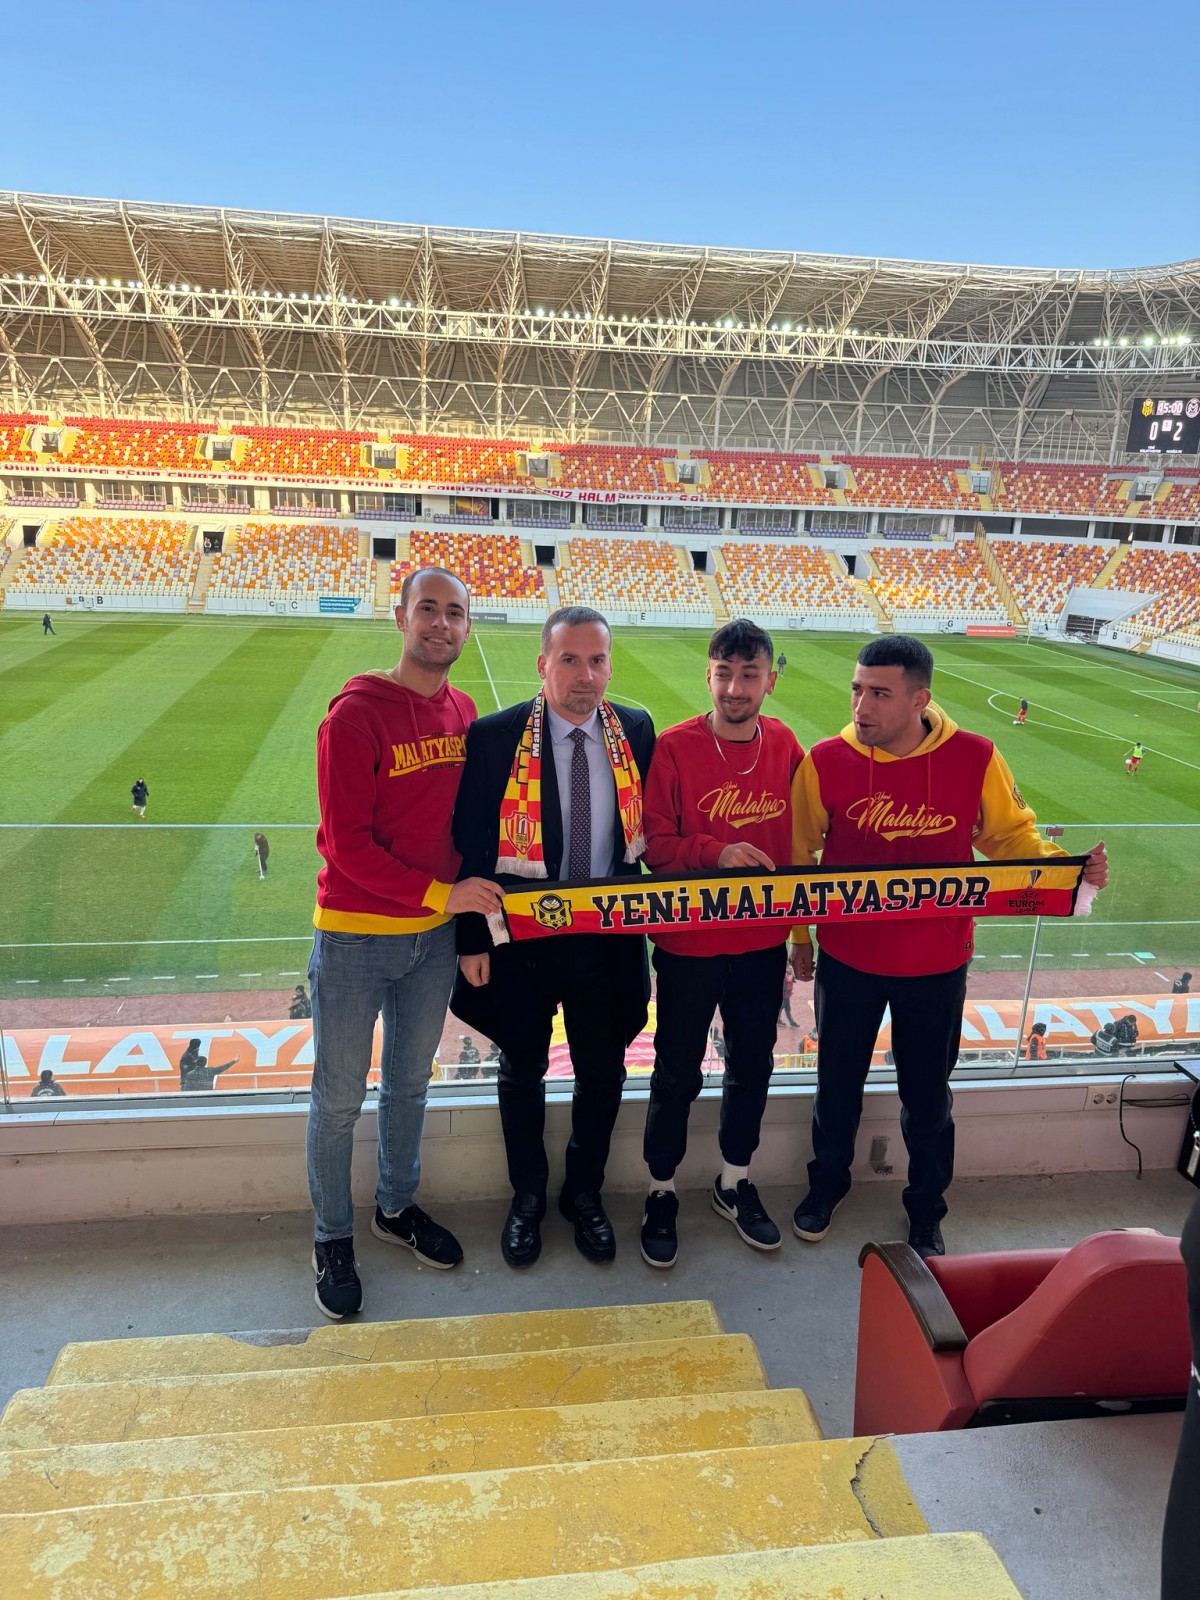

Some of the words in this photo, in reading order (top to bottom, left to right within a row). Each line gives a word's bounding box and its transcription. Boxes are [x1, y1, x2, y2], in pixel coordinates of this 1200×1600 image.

[1149, 421, 1159, 441] 0
[1173, 421, 1183, 442] 2
[697, 788, 787, 826] Malatya
[846, 797, 957, 839] Malatya
[698, 875, 992, 923] MALATYASPOR
